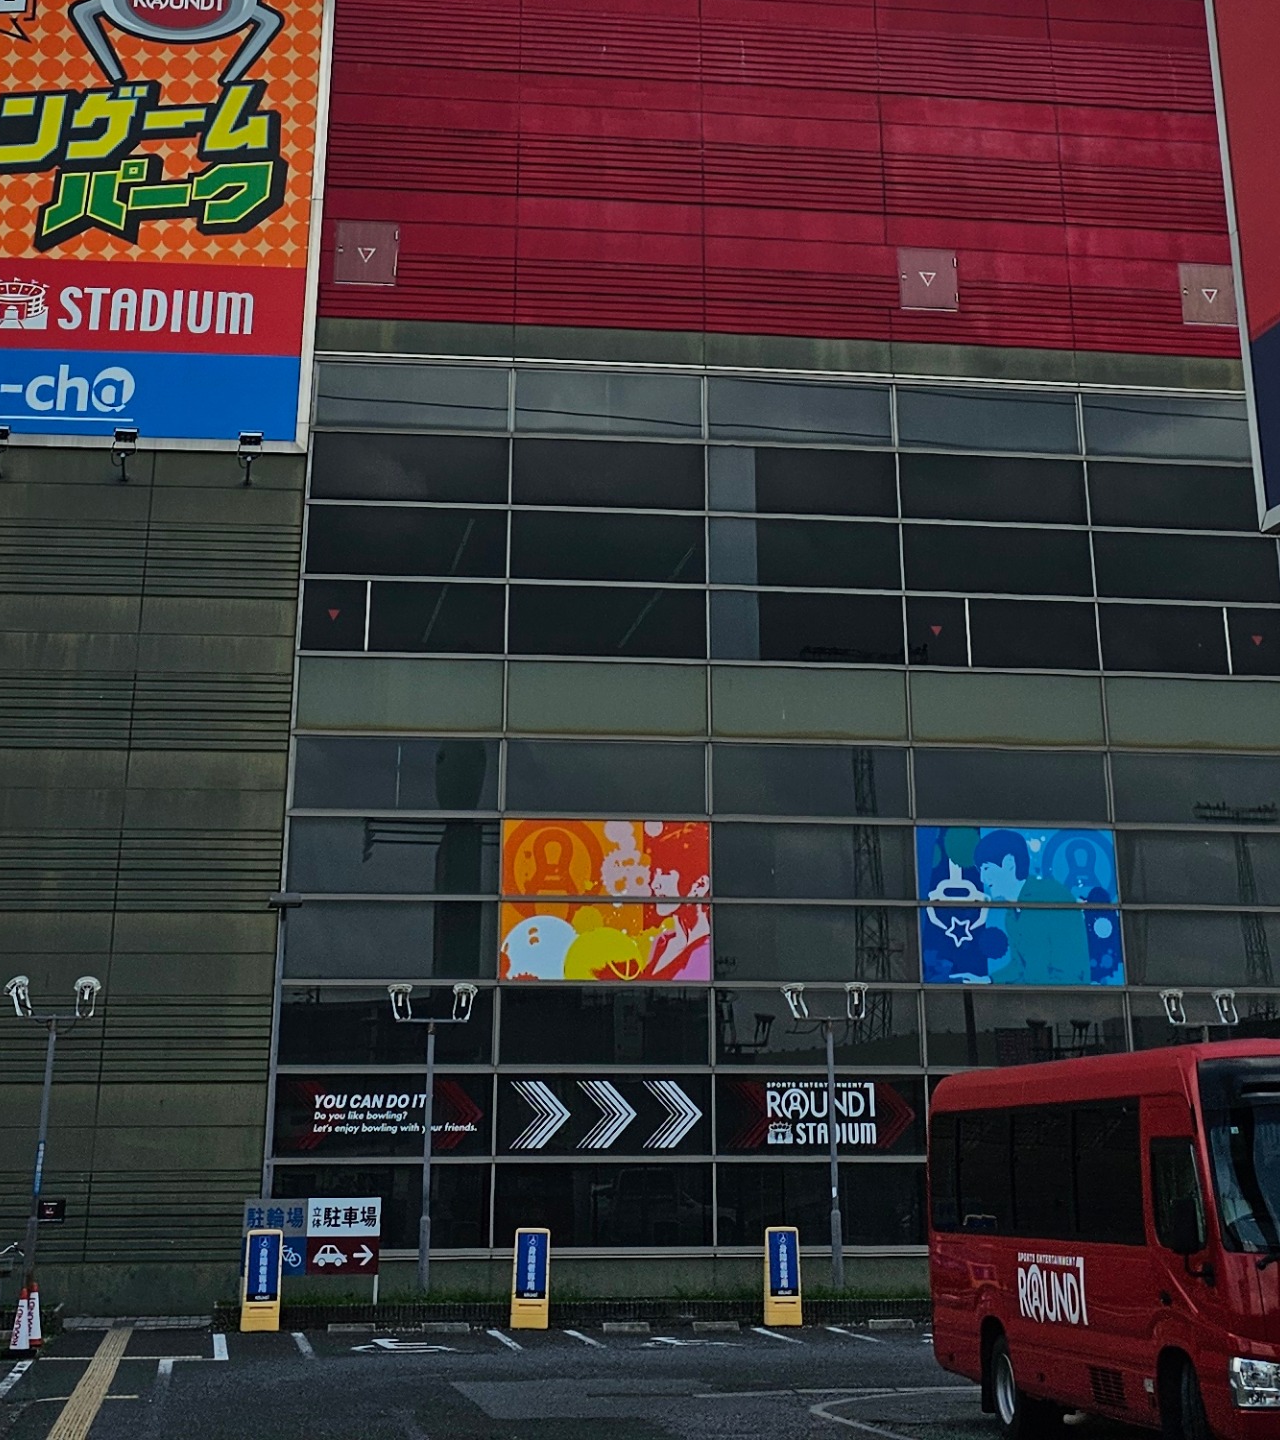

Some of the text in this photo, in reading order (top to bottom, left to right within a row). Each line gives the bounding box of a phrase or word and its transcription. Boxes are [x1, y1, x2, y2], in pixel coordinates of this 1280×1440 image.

[42, 160, 274, 237] パーク
[58, 285, 254, 335] STADIUM
[314, 1094, 347, 1109] YOU
[349, 1094, 384, 1109] CAN
[386, 1094, 410, 1109] DO
[314, 1111, 408, 1122] Do you like bowling?
[335, 1124, 360, 1134] enjoy
[361, 1124, 398, 1135] bowling
[400, 1124, 420, 1133] with
[444, 1122, 478, 1133] friends.
[246, 1207, 304, 1228] 駐輪場
[323, 1206, 378, 1228] 駐車場
[1018, 1256, 1089, 1326] ROUND1
